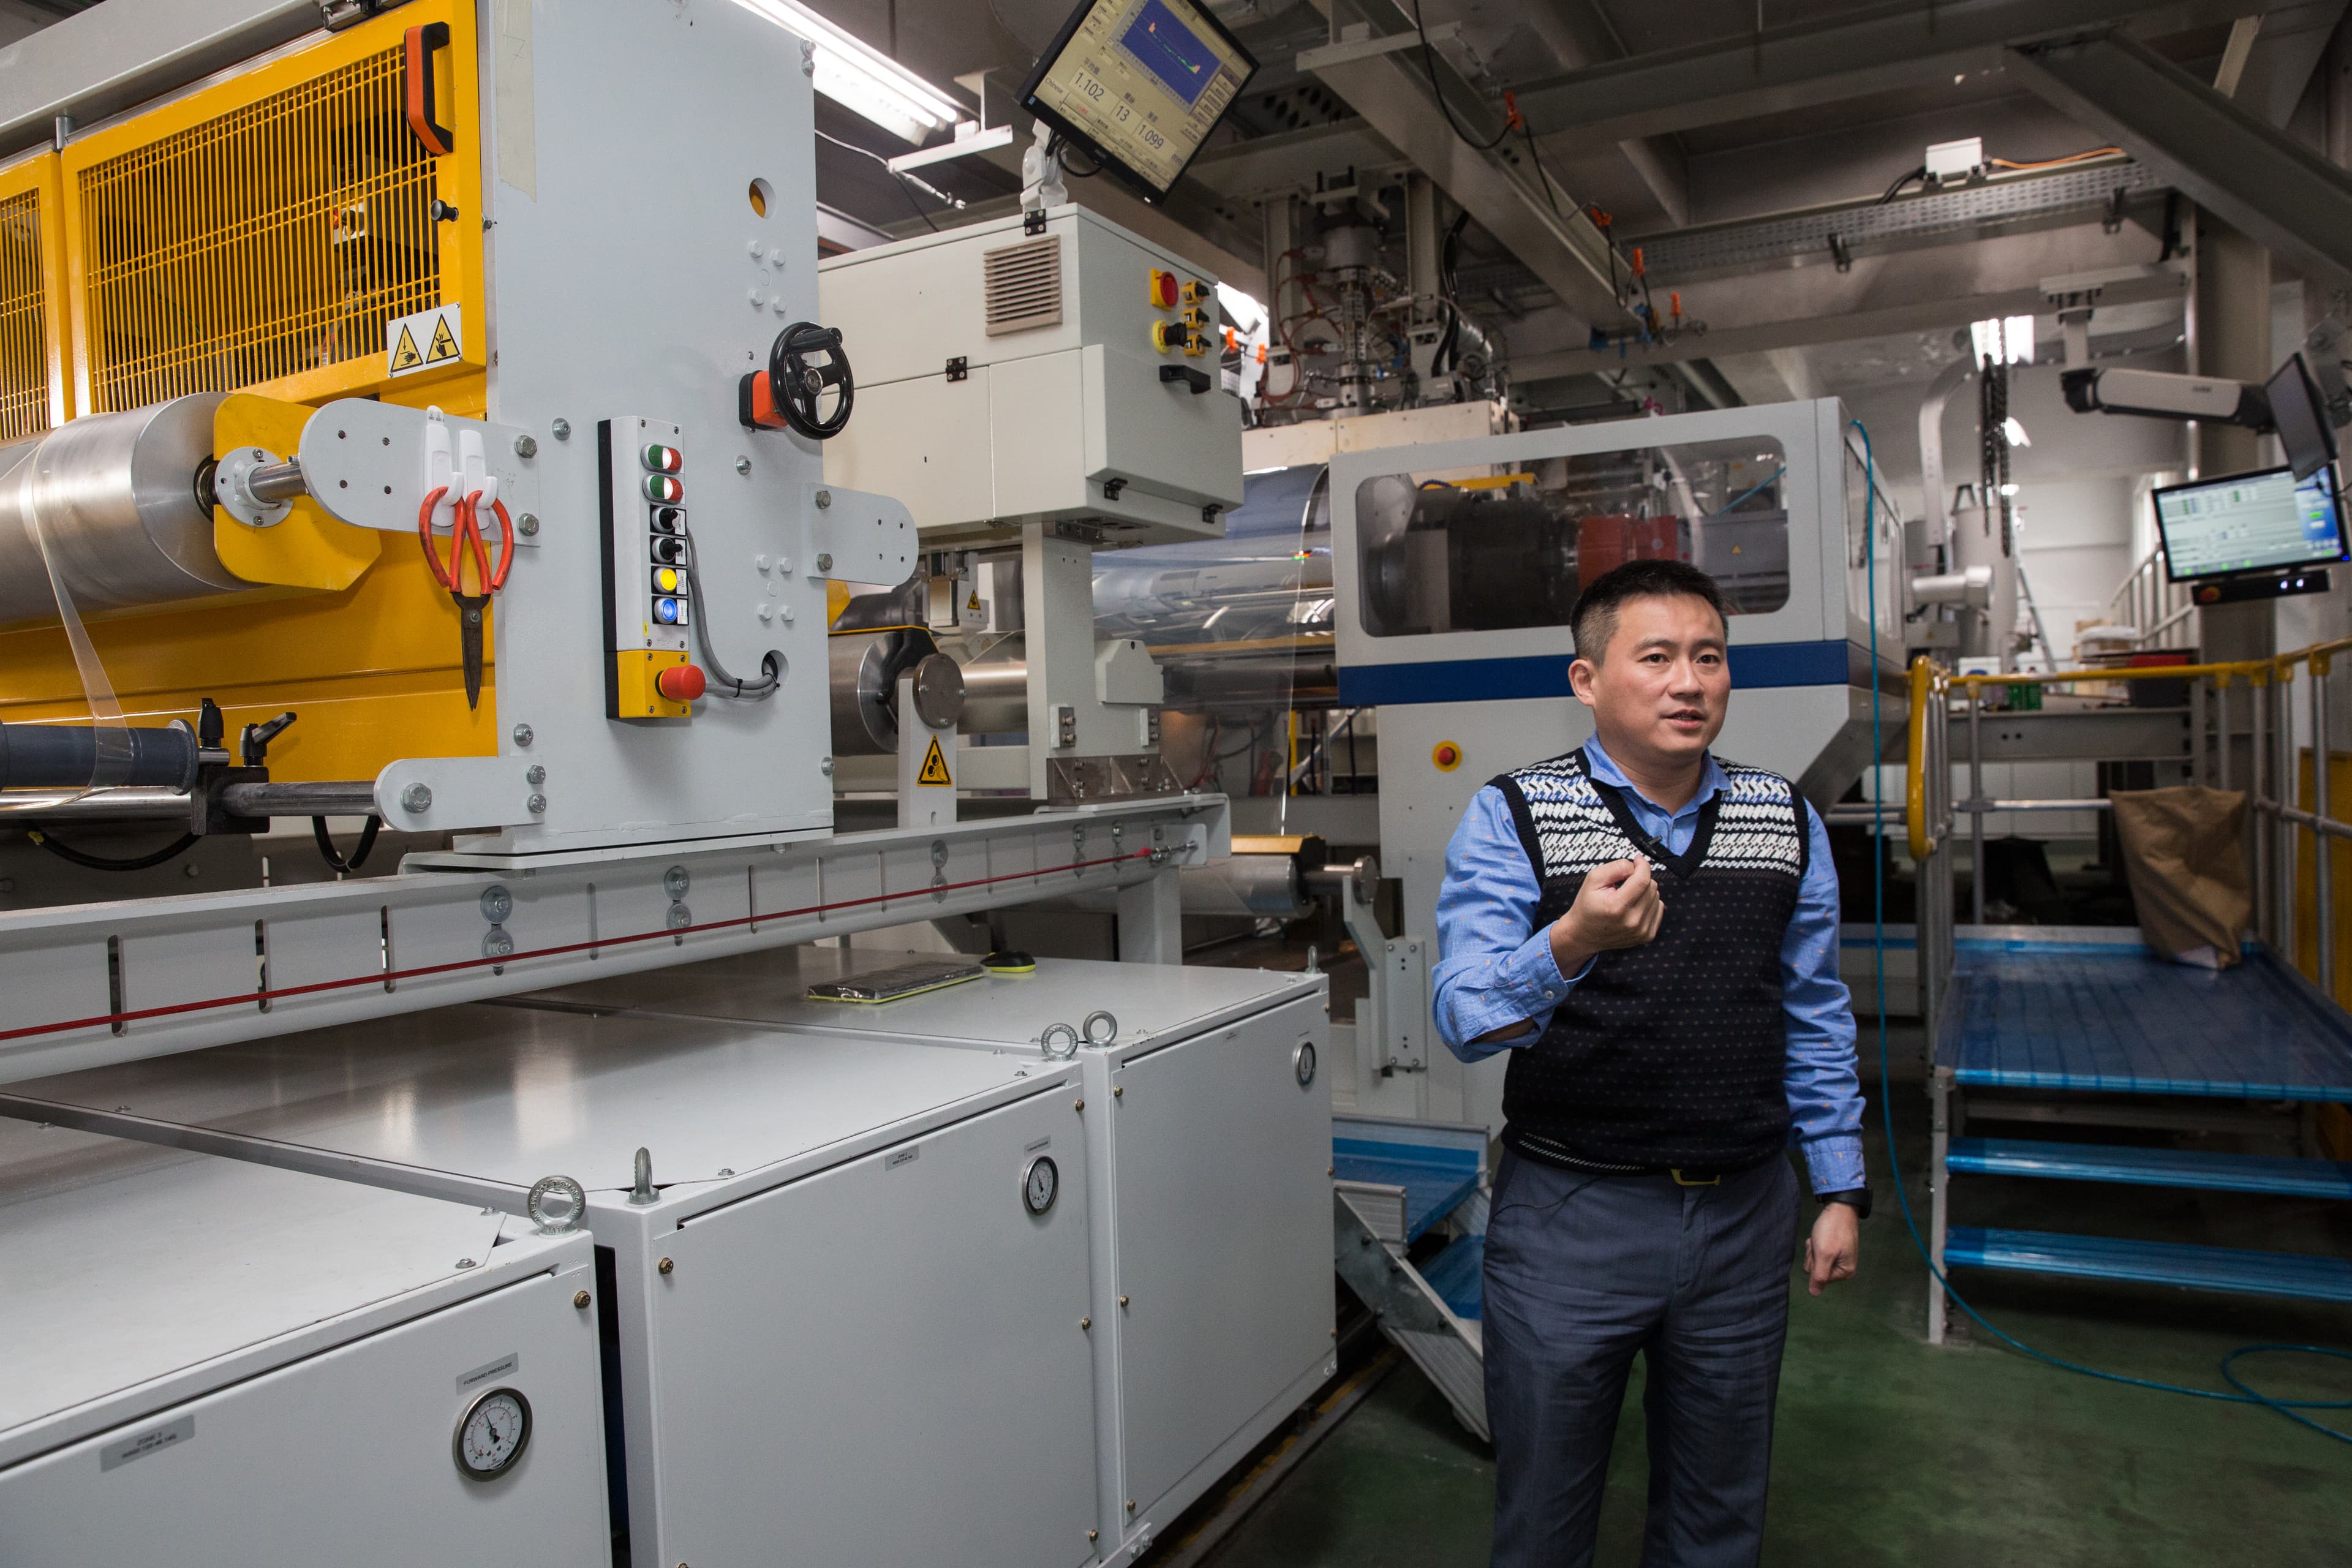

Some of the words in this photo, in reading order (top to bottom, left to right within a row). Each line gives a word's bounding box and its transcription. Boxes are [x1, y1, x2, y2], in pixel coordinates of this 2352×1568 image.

[1045, 77, 1064, 94] Chinese
[1075, 72, 1104, 102] 1.102
[1115, 105, 1131, 122] 13
[1138, 124, 1164, 149] 1.099
[464, 1373, 488, 1385] FORWARD
[488, 1362, 512, 1376] PRESSURE
